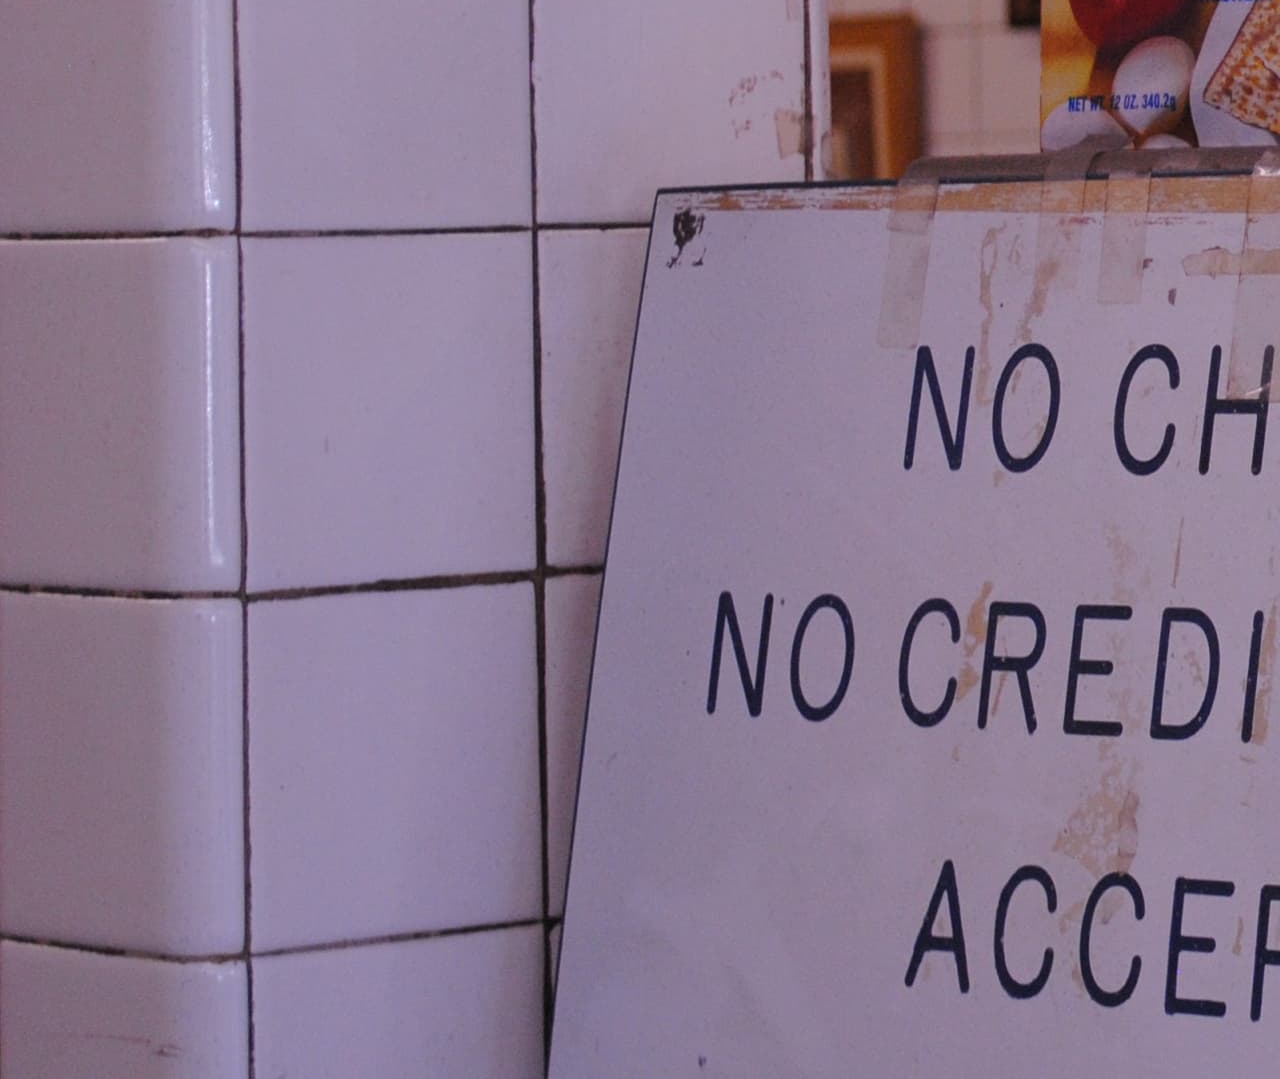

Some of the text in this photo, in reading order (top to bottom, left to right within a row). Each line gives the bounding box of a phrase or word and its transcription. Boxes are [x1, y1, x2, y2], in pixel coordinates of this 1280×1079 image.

[1068, 95, 1086, 112] NET
[1123, 94, 1139, 110] OZ.
[902, 343, 1061, 473] NO
[705, 590, 856, 722] NO
